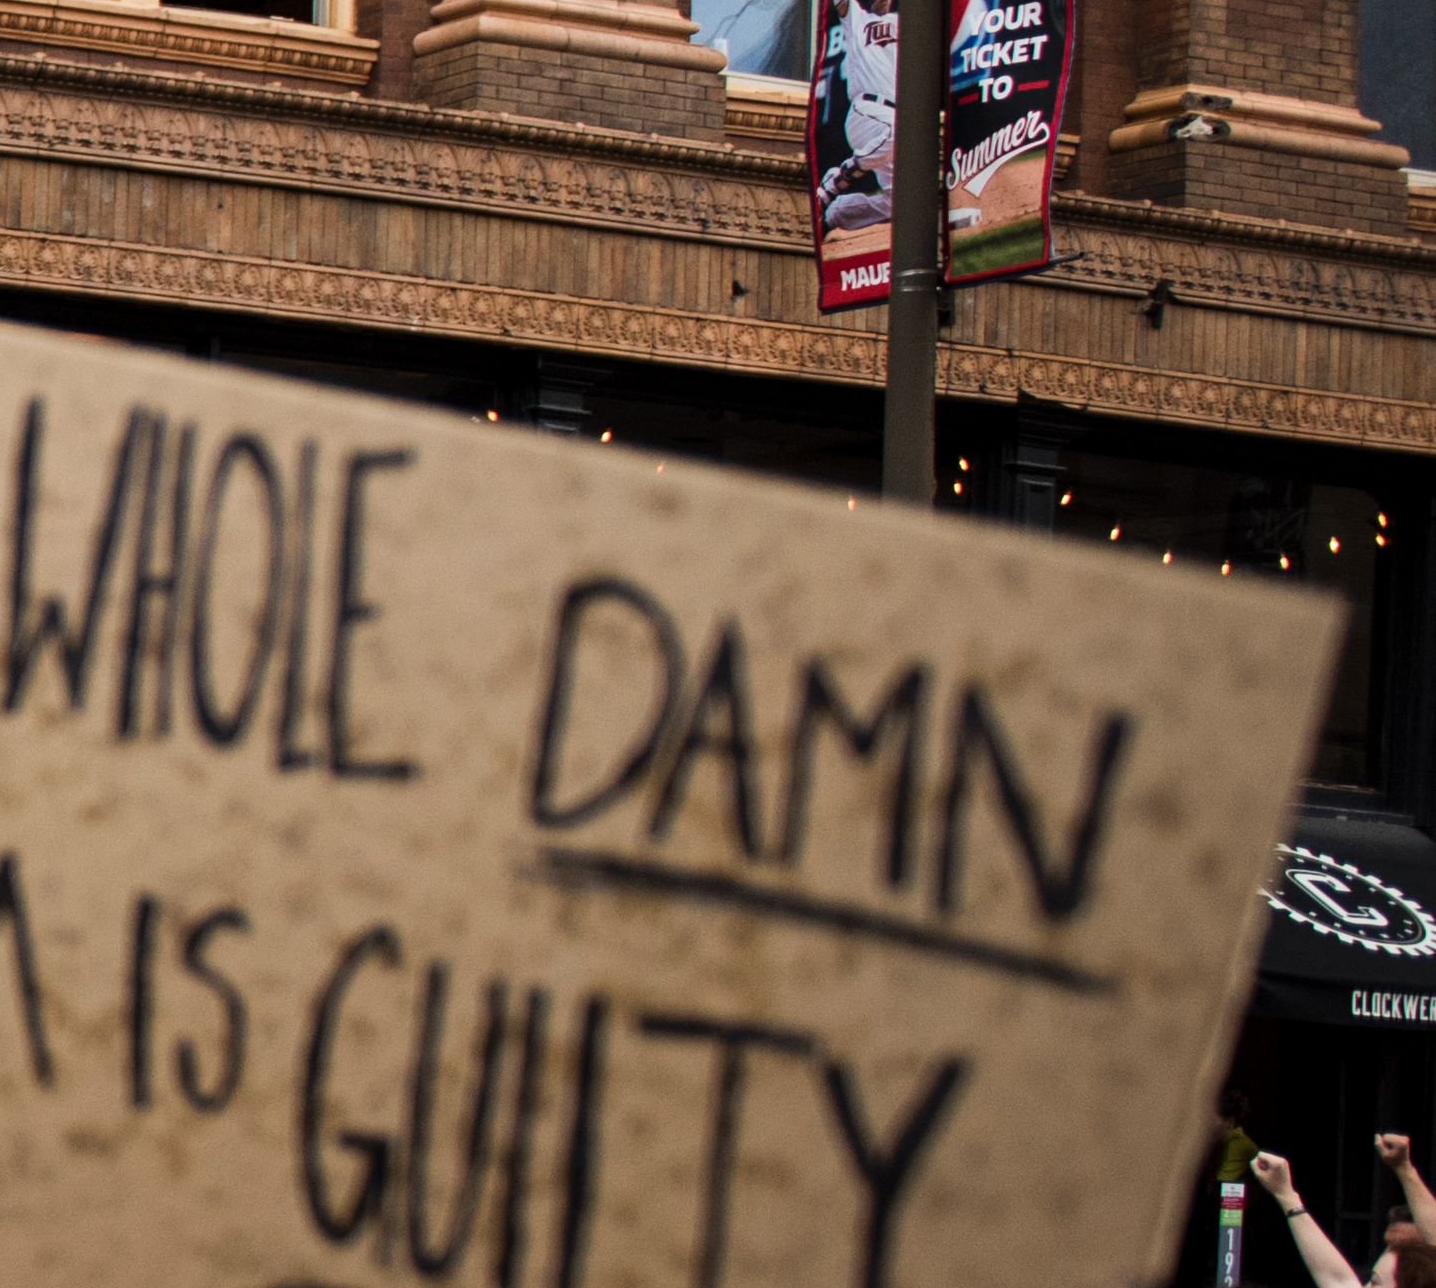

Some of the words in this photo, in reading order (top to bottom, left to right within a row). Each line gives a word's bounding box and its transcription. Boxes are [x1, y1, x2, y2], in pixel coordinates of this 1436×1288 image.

[969, 1, 1043, 36] YOUR
[960, 34, 1048, 74] TICKET
[978, 74, 1015, 103] TO
[945, 110, 1050, 193] Summer
[0, 395, 425, 782] WHOLE
[528, 574, 1136, 926] DAMN
[127, 891, 253, 1115] IS
